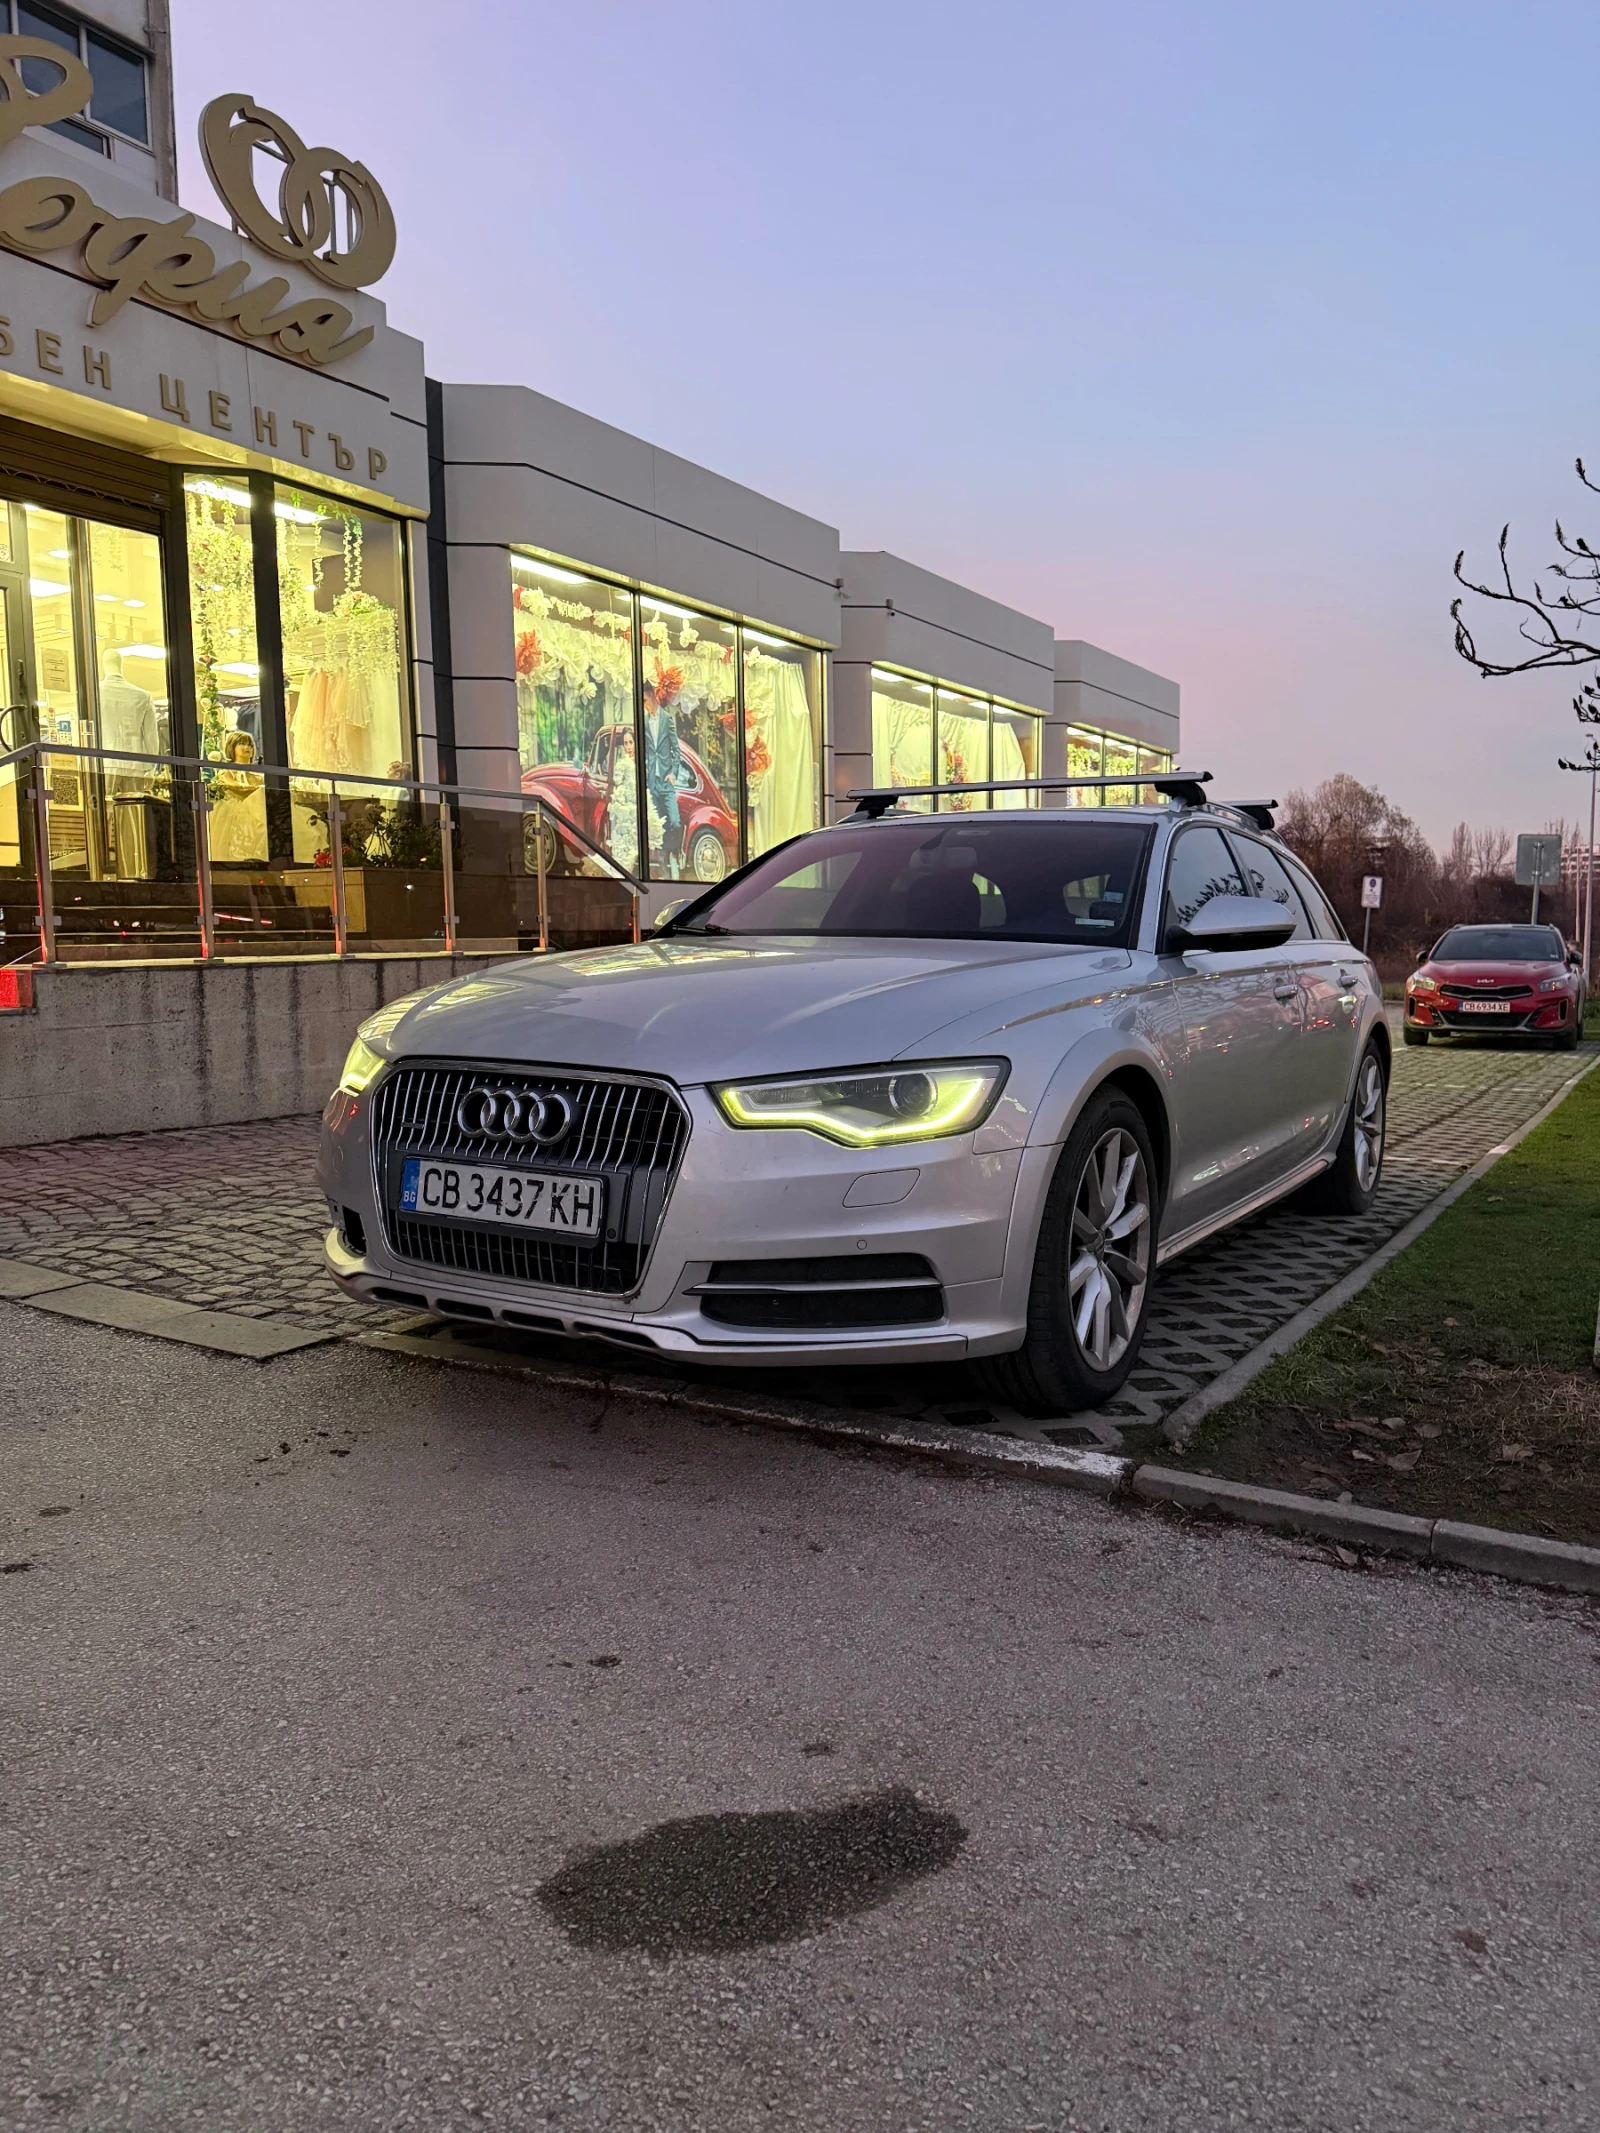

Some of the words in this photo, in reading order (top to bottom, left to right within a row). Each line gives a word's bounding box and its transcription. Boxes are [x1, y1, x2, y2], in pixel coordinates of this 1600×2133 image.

[159, 372, 388, 481] ЦЕНТЪР
[1464, 1002, 1475, 1011] CB
[1476, 1002, 1497, 1011] 6934
[403, 1190, 416, 1203] BG
[423, 1168, 460, 1210] CB
[466, 1172, 544, 1219] 3437
[550, 1182, 594, 1228] KH
